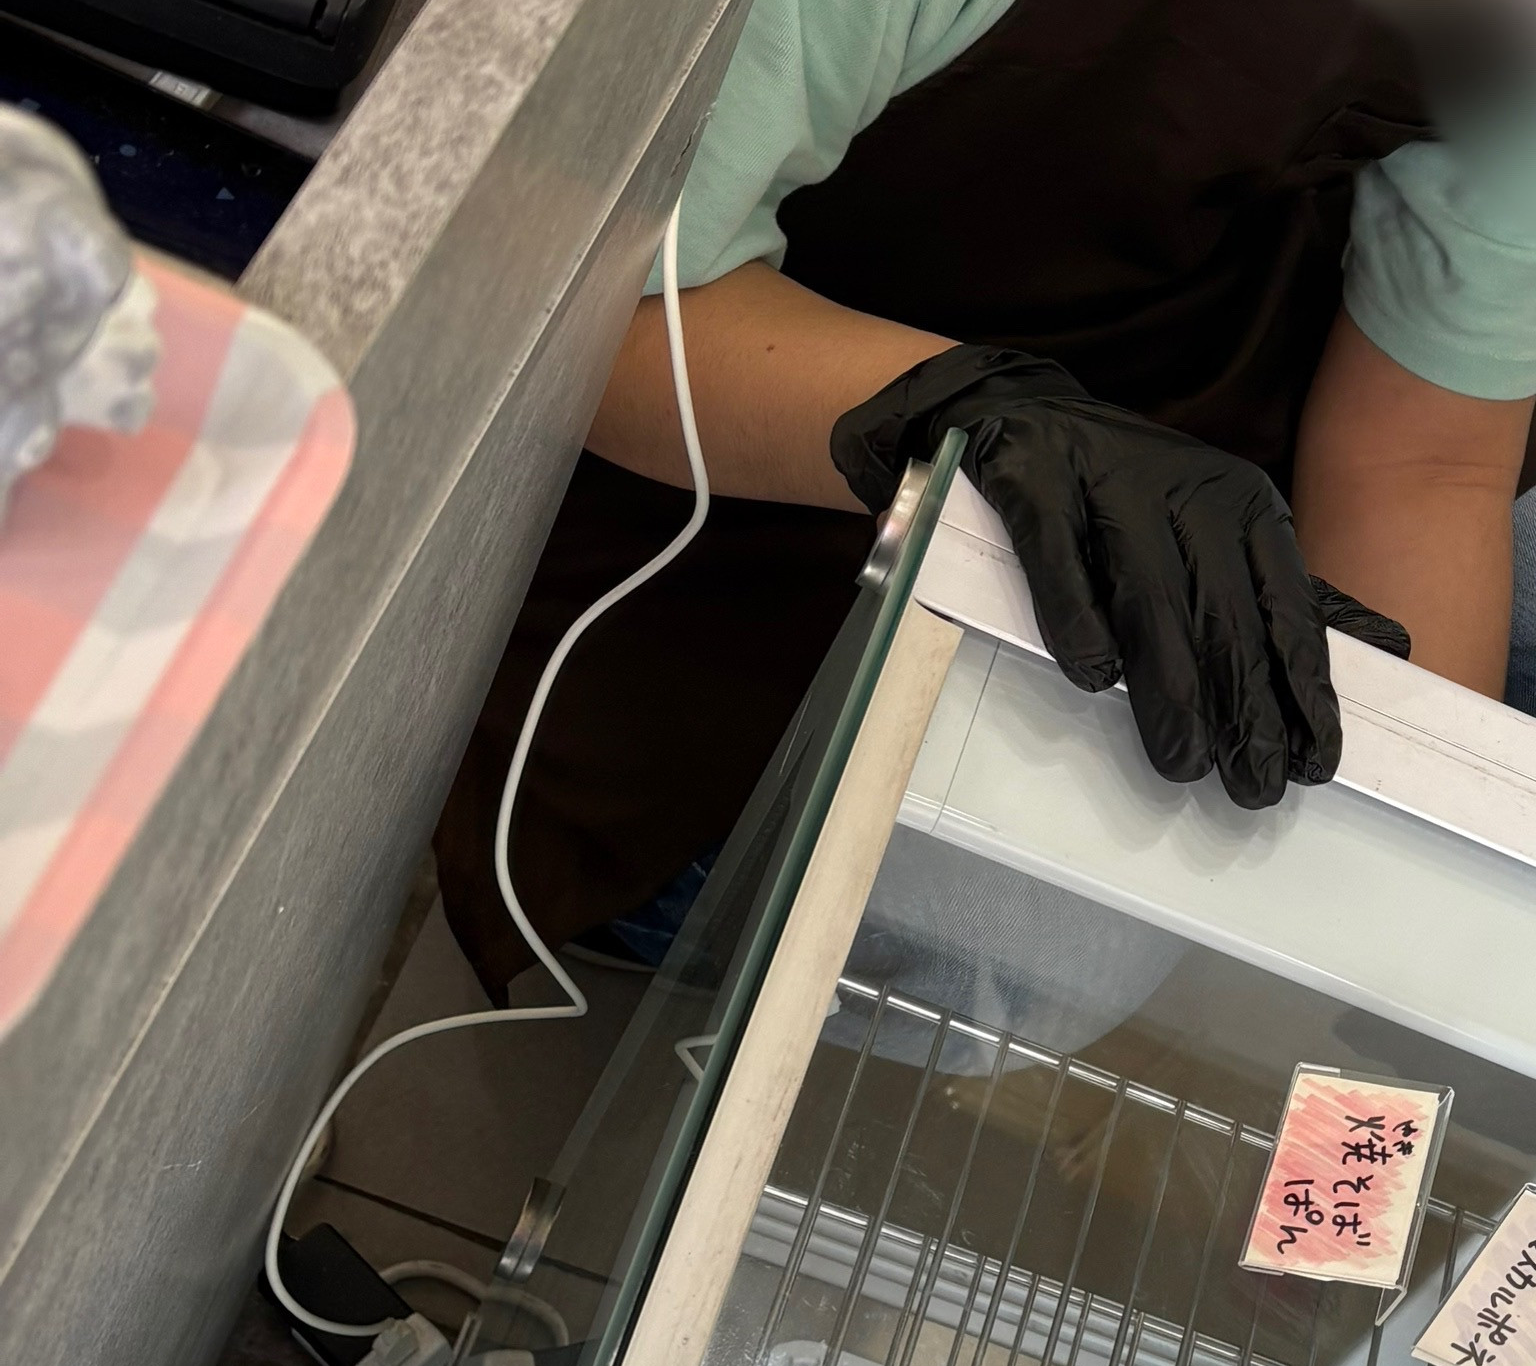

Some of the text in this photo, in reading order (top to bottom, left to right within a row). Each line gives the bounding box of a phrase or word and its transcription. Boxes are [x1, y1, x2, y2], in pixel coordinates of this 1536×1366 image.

[1277, 1179, 1325, 1255] ぱん
[1332, 1115, 1392, 1247] 焼そば
